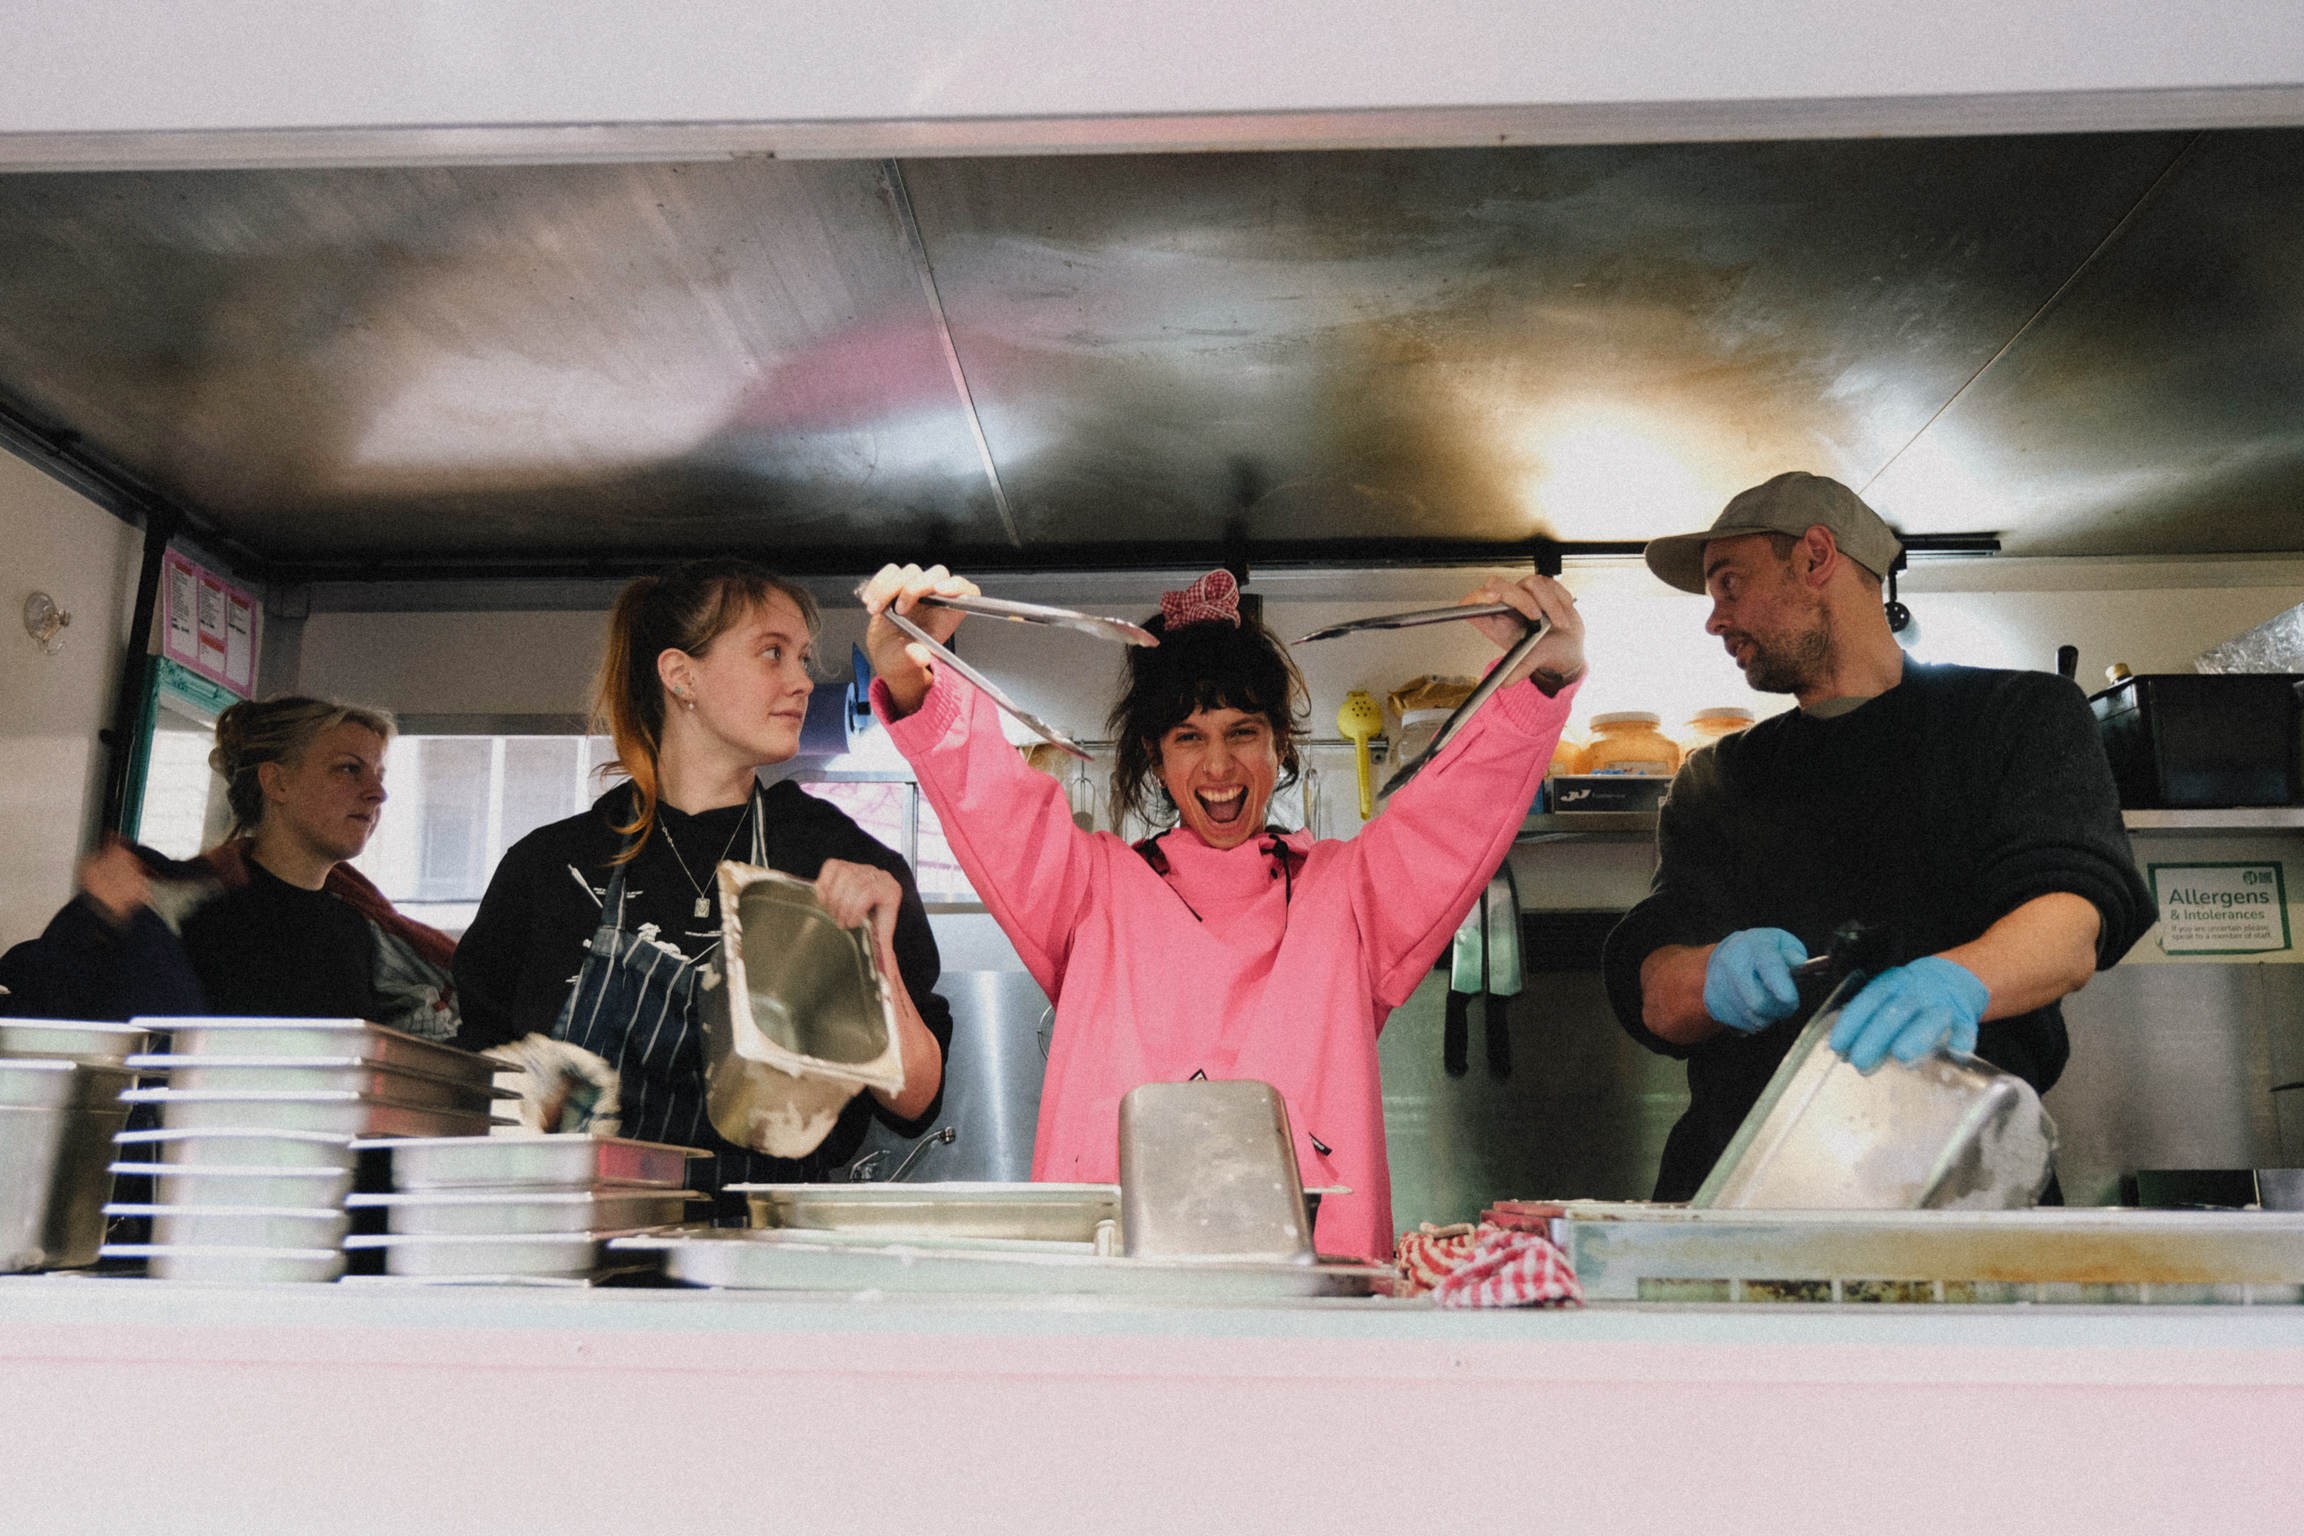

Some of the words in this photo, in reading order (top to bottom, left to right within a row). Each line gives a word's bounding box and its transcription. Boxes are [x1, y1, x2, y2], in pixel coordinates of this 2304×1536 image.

[2168, 888, 2270, 908] Allergens
[2170, 909, 2180, 920] &
[2184, 909, 2265, 920] Intolerances
